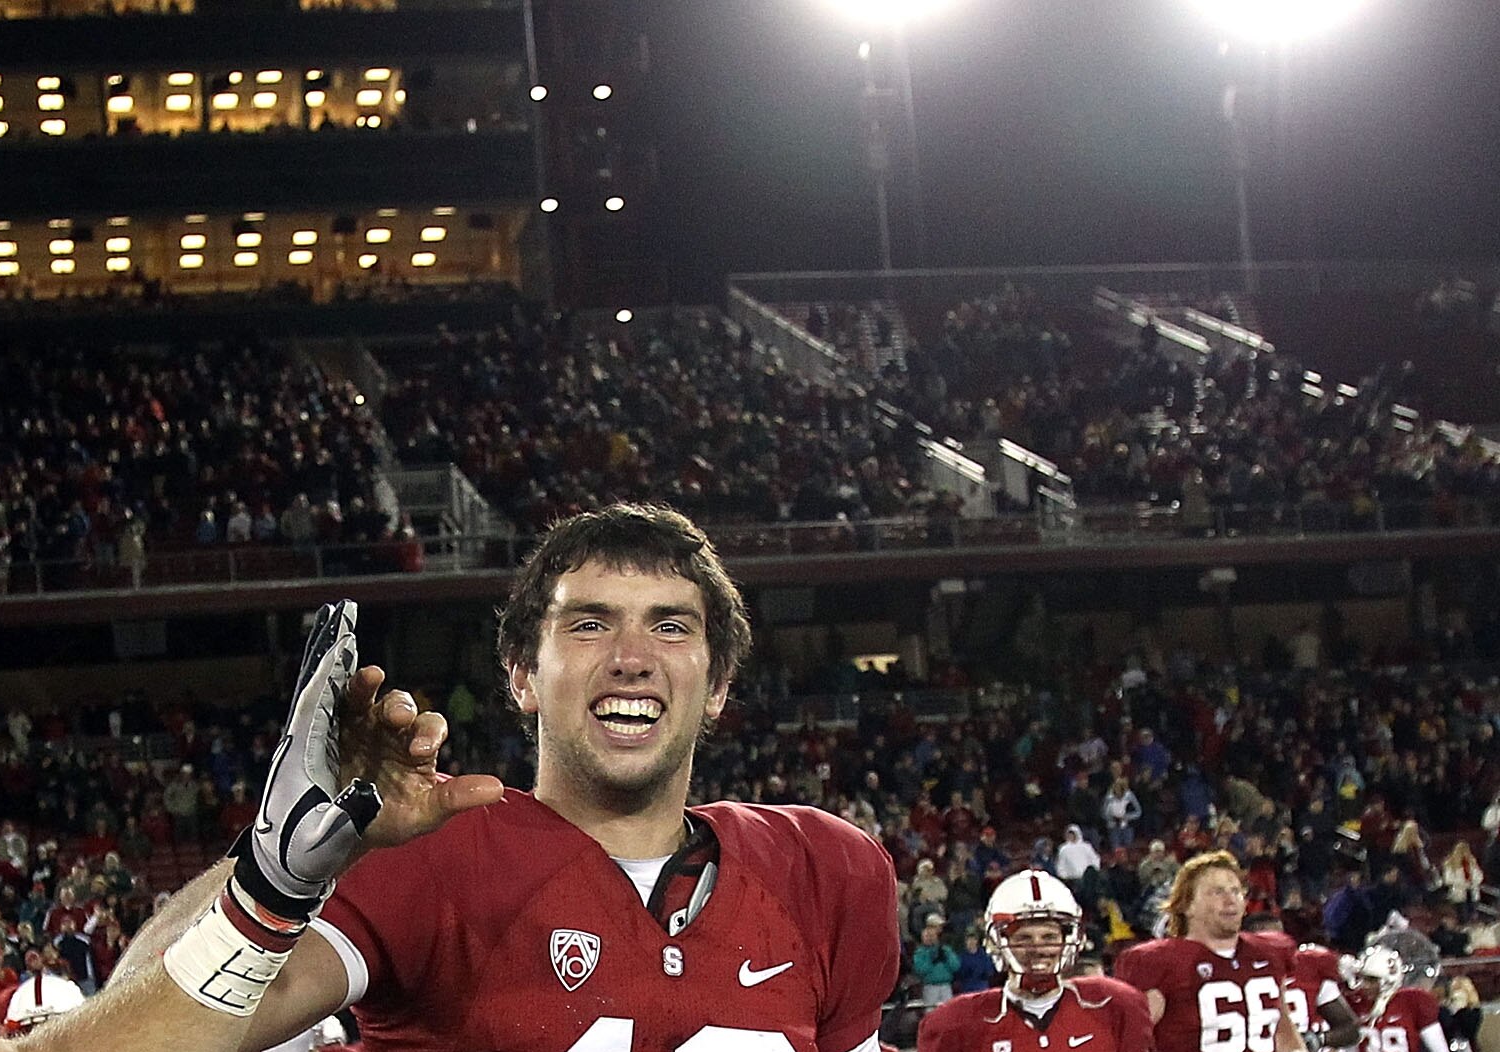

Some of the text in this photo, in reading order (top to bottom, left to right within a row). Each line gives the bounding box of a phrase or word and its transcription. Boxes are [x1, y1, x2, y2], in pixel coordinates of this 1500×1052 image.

[553, 932, 597, 970] PAC
[561, 954, 588, 979] 10
[662, 945, 684, 976] S
